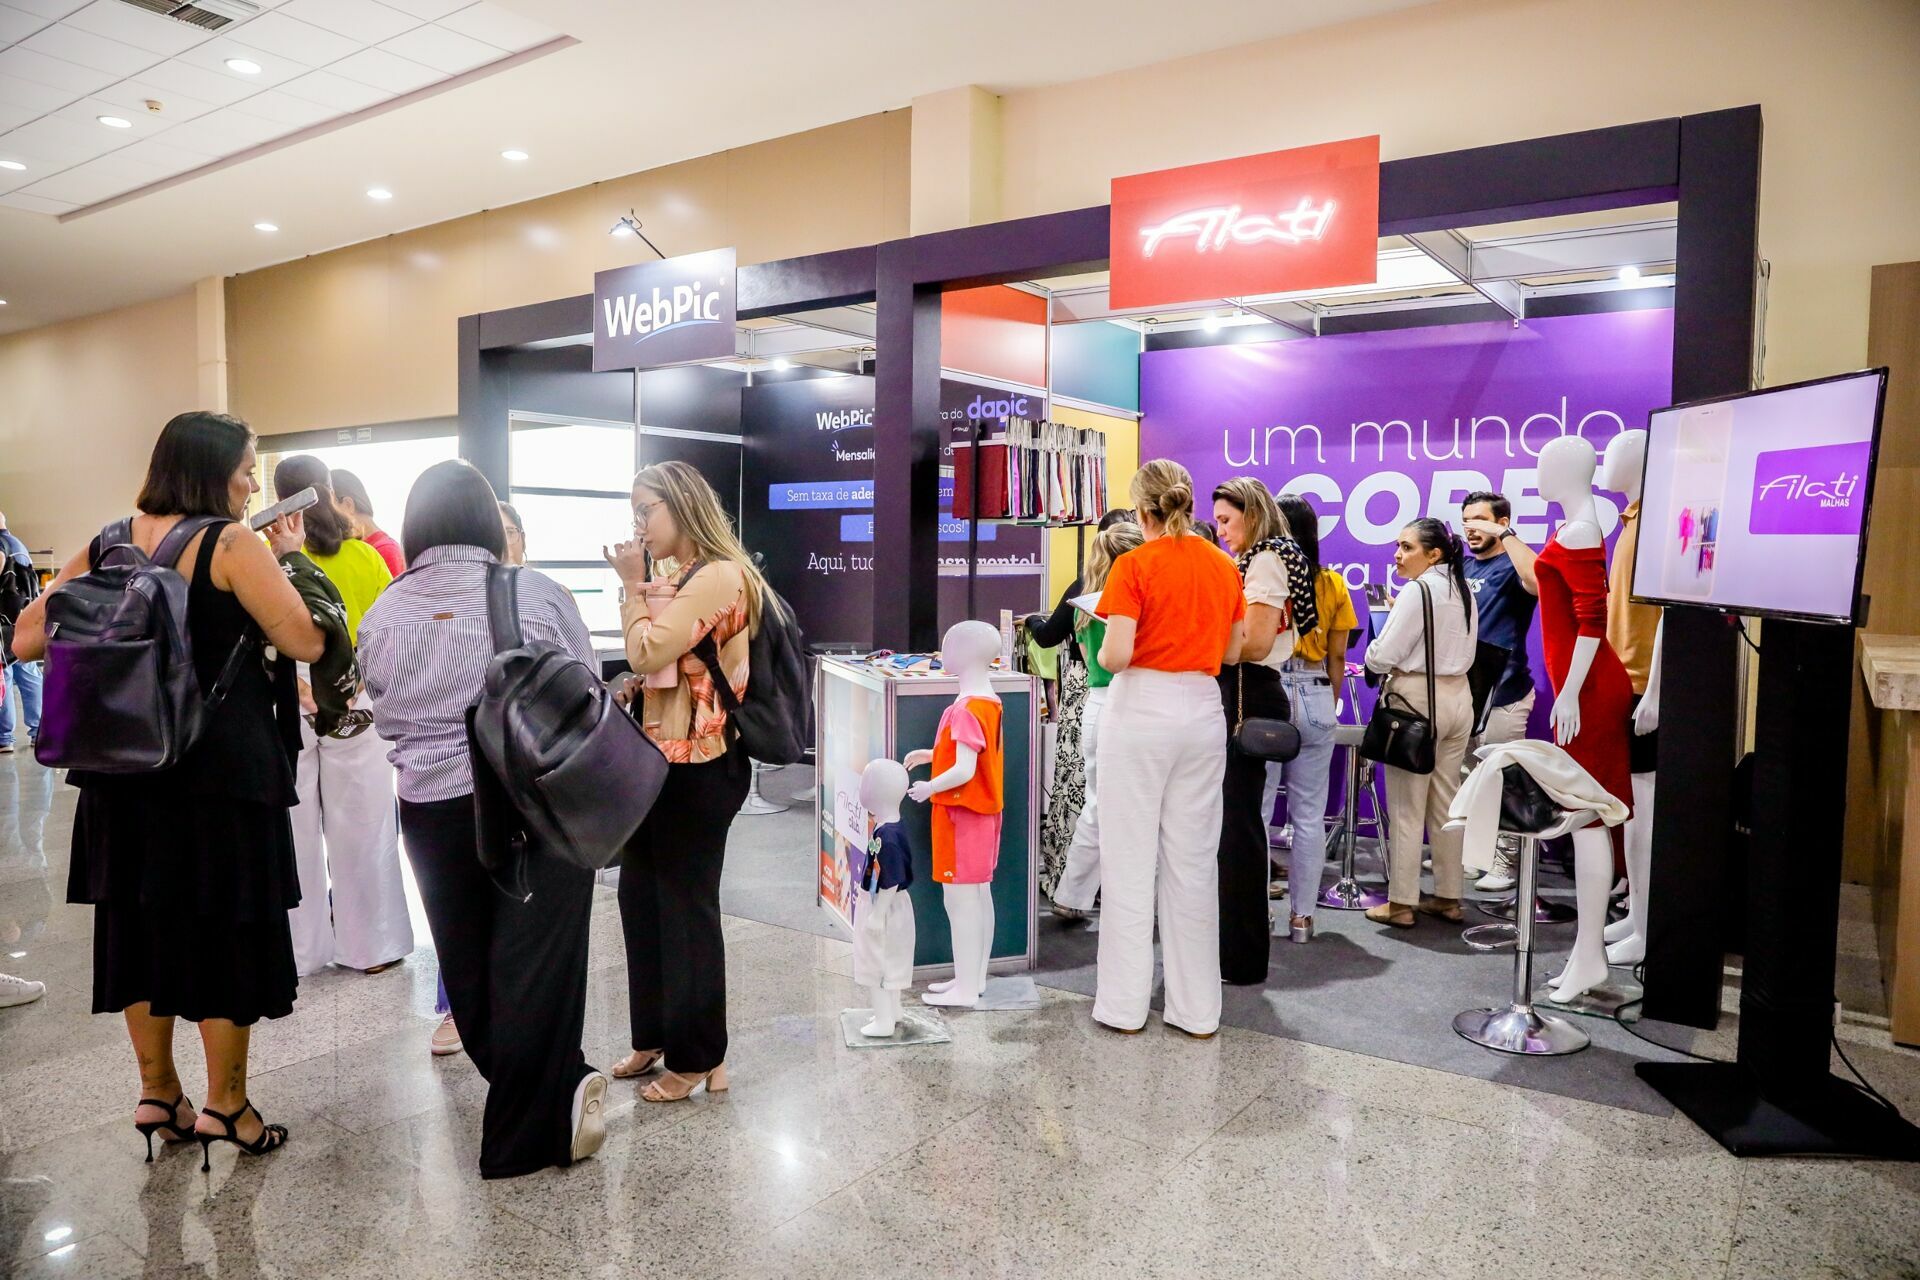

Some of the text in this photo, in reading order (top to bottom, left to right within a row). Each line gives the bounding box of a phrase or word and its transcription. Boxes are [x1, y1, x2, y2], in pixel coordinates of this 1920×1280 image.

[603, 281, 720, 338] WebPic
[816, 408, 873, 431] WebPic
[949, 408, 963, 420] do
[1223, 396, 1626, 468] um mundo
[787, 489, 809, 502] Sem
[811, 490, 833, 501] taxa
[836, 488, 849, 501] de
[1759, 471, 1859, 501] Filati
[1820, 498, 1850, 508] MALHAS
[807, 552, 847, 575] Aqui,
